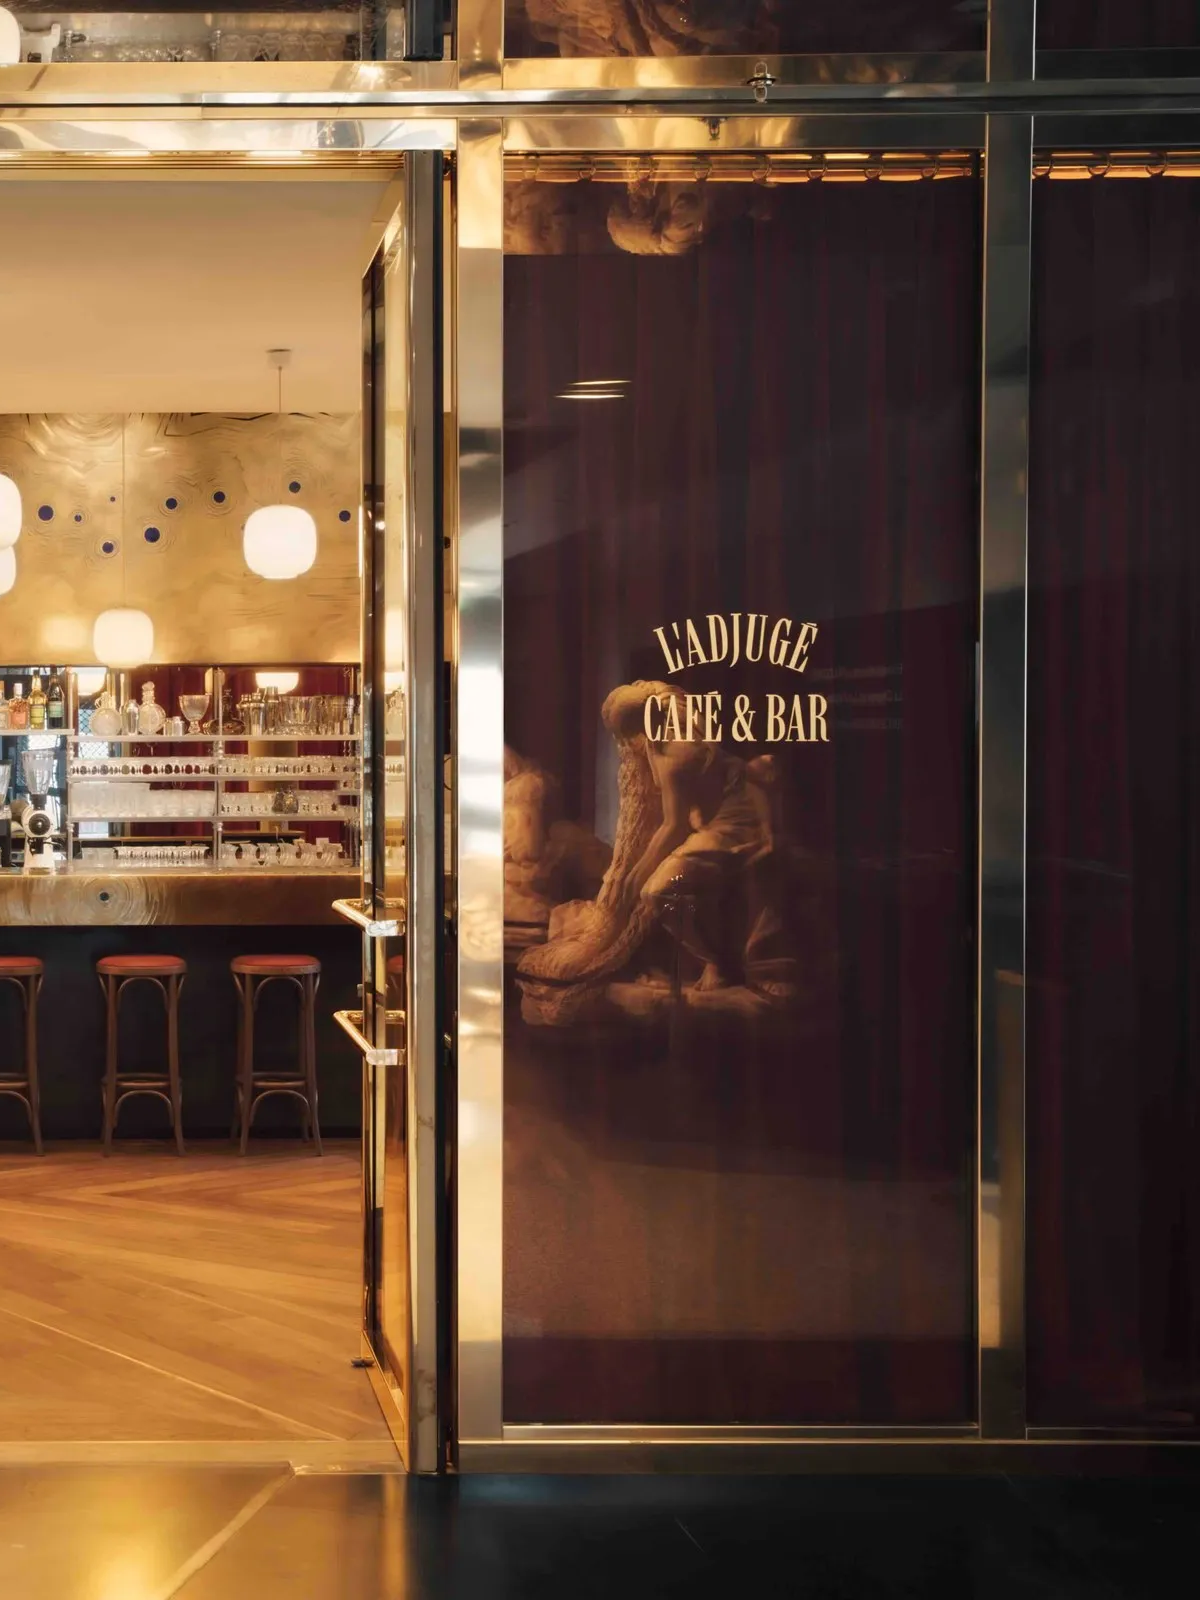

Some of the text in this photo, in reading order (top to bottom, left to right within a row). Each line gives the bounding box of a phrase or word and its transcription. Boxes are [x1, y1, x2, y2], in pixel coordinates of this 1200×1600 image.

[653, 613, 818, 673] L'ADJUGÉ
[644, 691, 830, 742] CAFÉ & BAR
